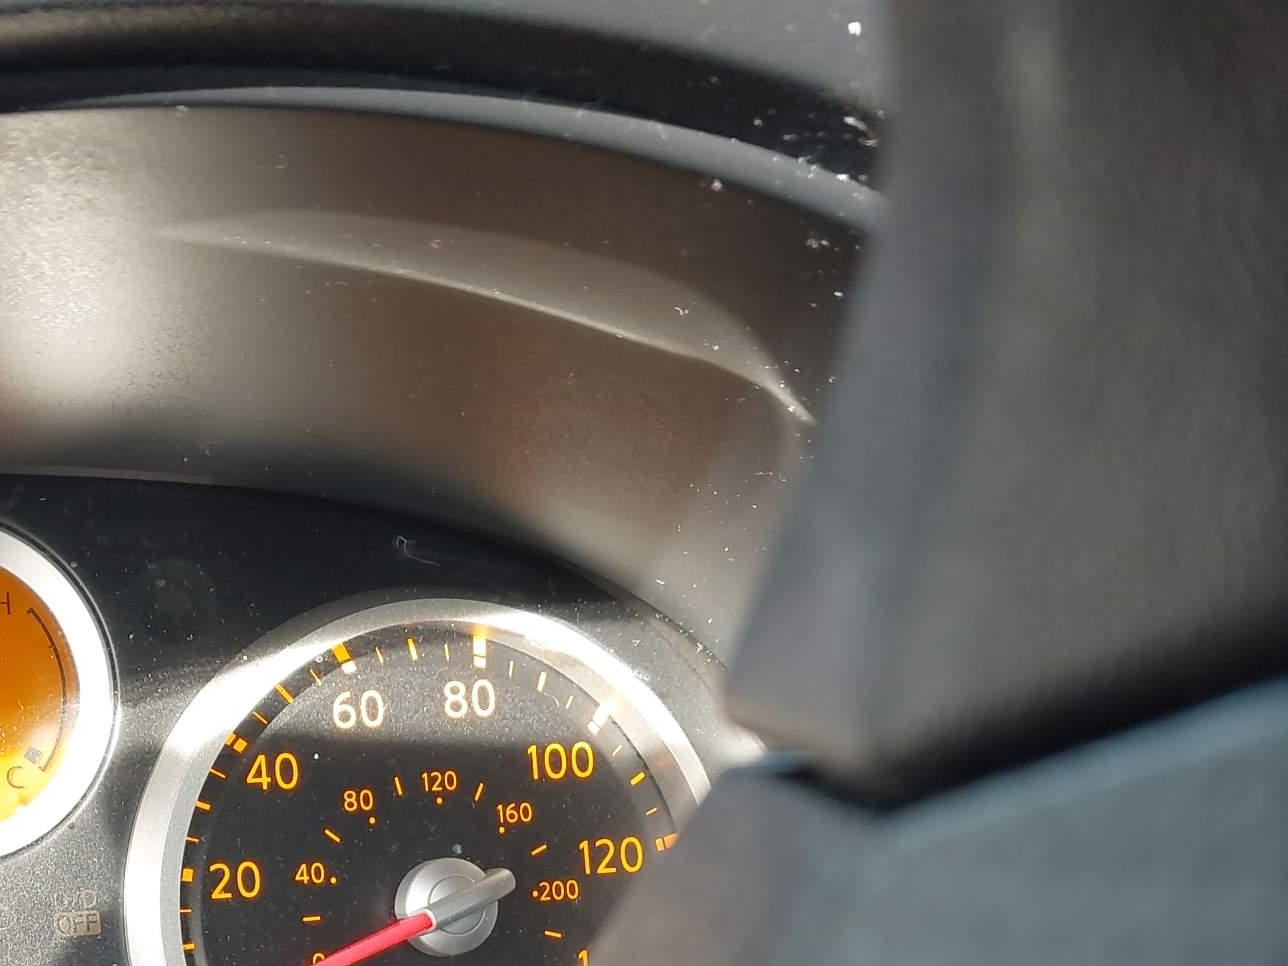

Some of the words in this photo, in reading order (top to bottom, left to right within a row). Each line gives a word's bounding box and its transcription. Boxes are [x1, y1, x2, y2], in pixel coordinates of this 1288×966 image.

[332, 689, 385, 729] 60
[443, 679, 496, 719] 80
[245, 751, 300, 791] 40
[527, 741, 595, 781] 100
[6, 765, 25, 789] C
[421, 771, 457, 792] 120
[342, 788, 374, 812] 80
[496, 802, 534, 824] 160
[578, 836, 644, 876] 120
[209, 861, 261, 899] 20
[294, 862, 325, 885] 40
[539, 880, 580, 902] 200
[58, 911, 98, 934] OFF
